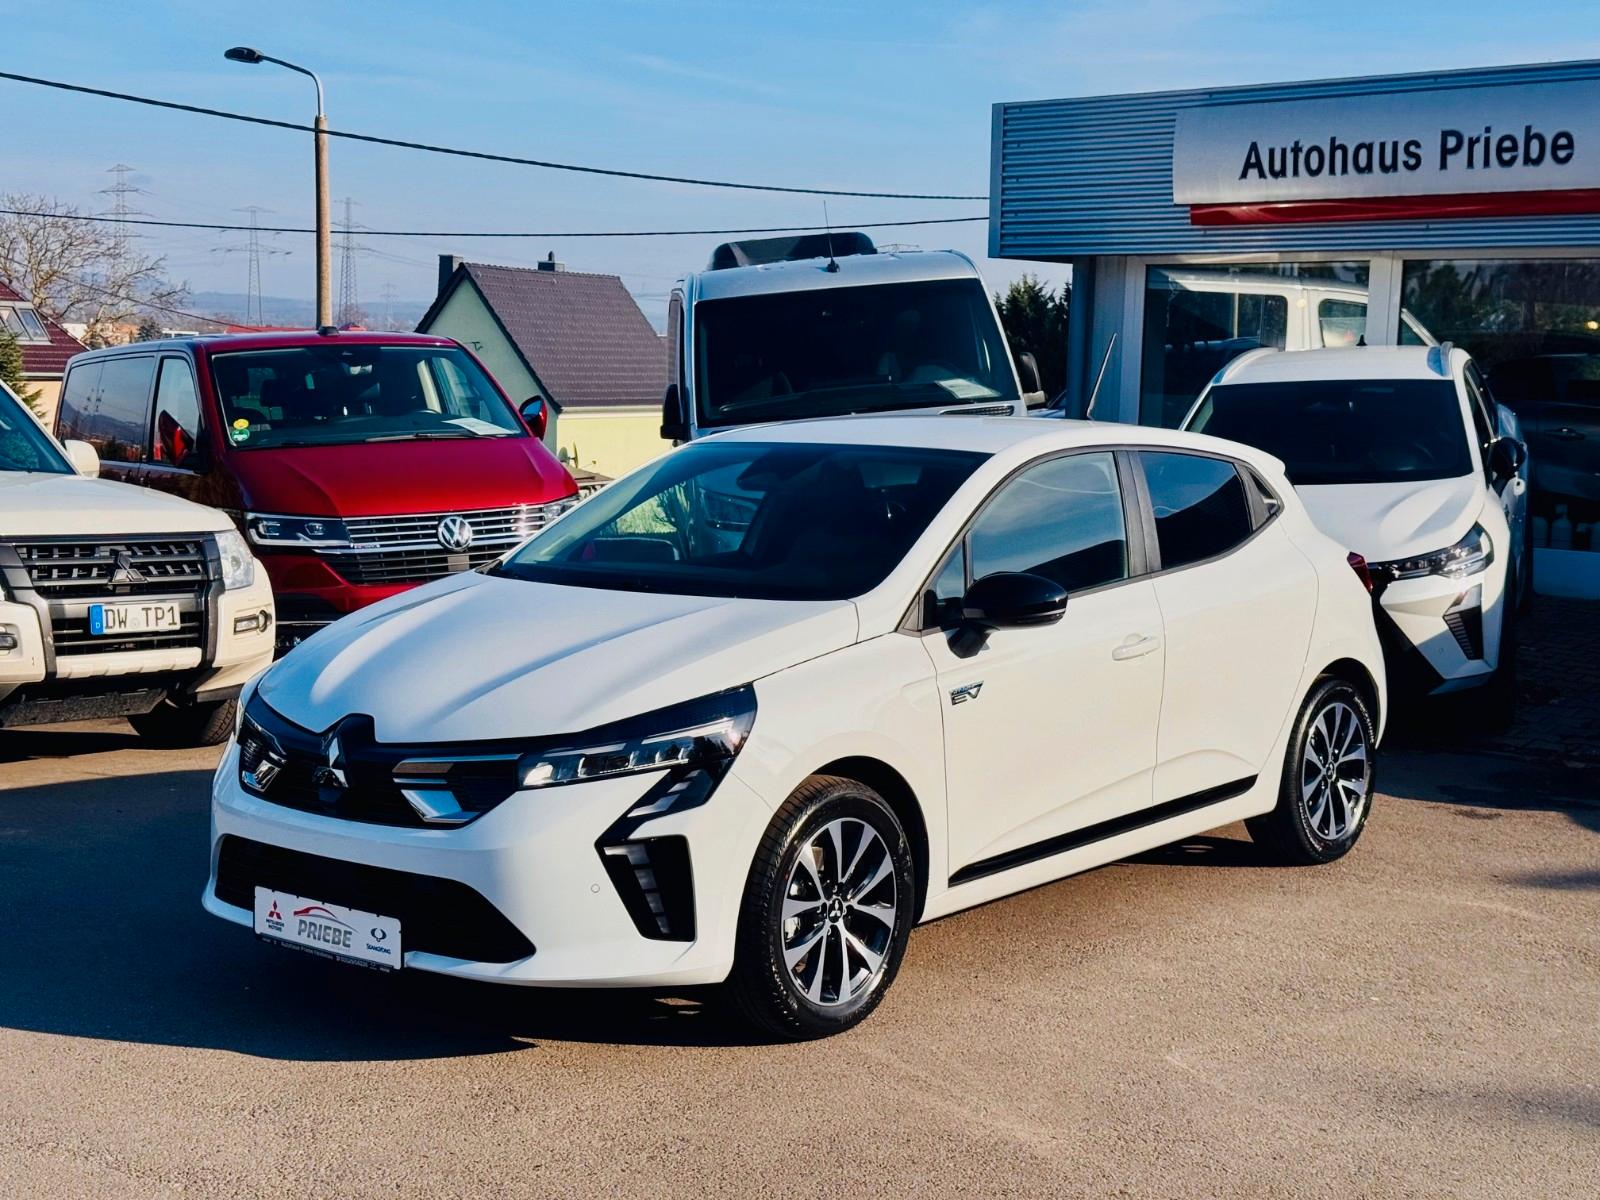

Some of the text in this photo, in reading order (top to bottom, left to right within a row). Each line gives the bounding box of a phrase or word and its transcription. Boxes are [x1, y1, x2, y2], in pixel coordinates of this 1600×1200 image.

[1239, 124, 1576, 180] Autohaus Priebe
[104, 606, 178, 629] DW TP1
[297, 919, 353, 948] PRIEBE
